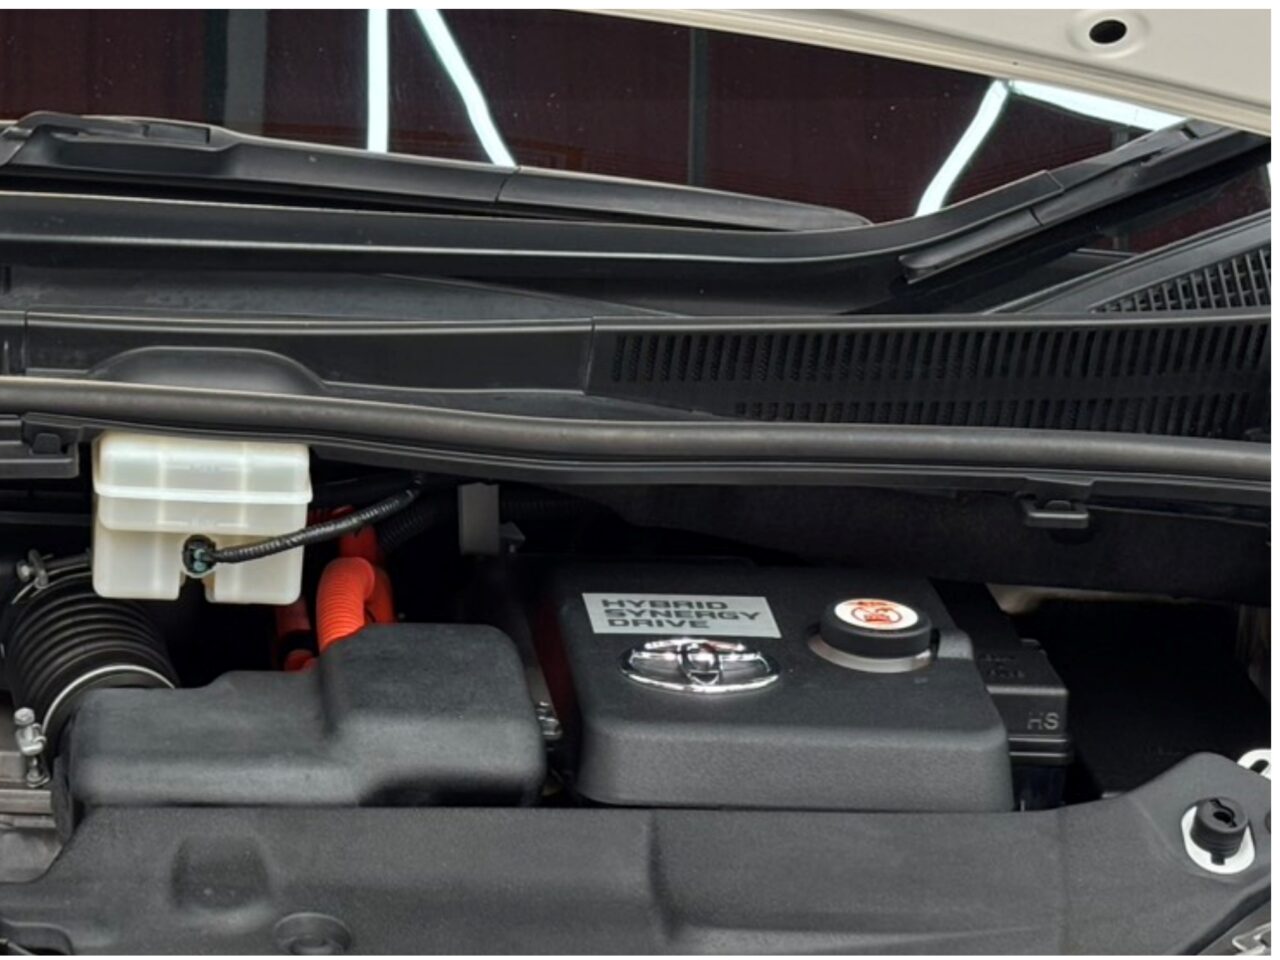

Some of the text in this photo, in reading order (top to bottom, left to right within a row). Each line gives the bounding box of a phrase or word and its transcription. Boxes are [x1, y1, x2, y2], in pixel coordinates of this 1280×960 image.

[601, 598, 729, 610] HYBRID
[604, 608, 761, 621] SYNERGY
[608, 619, 711, 629] DRIVE
